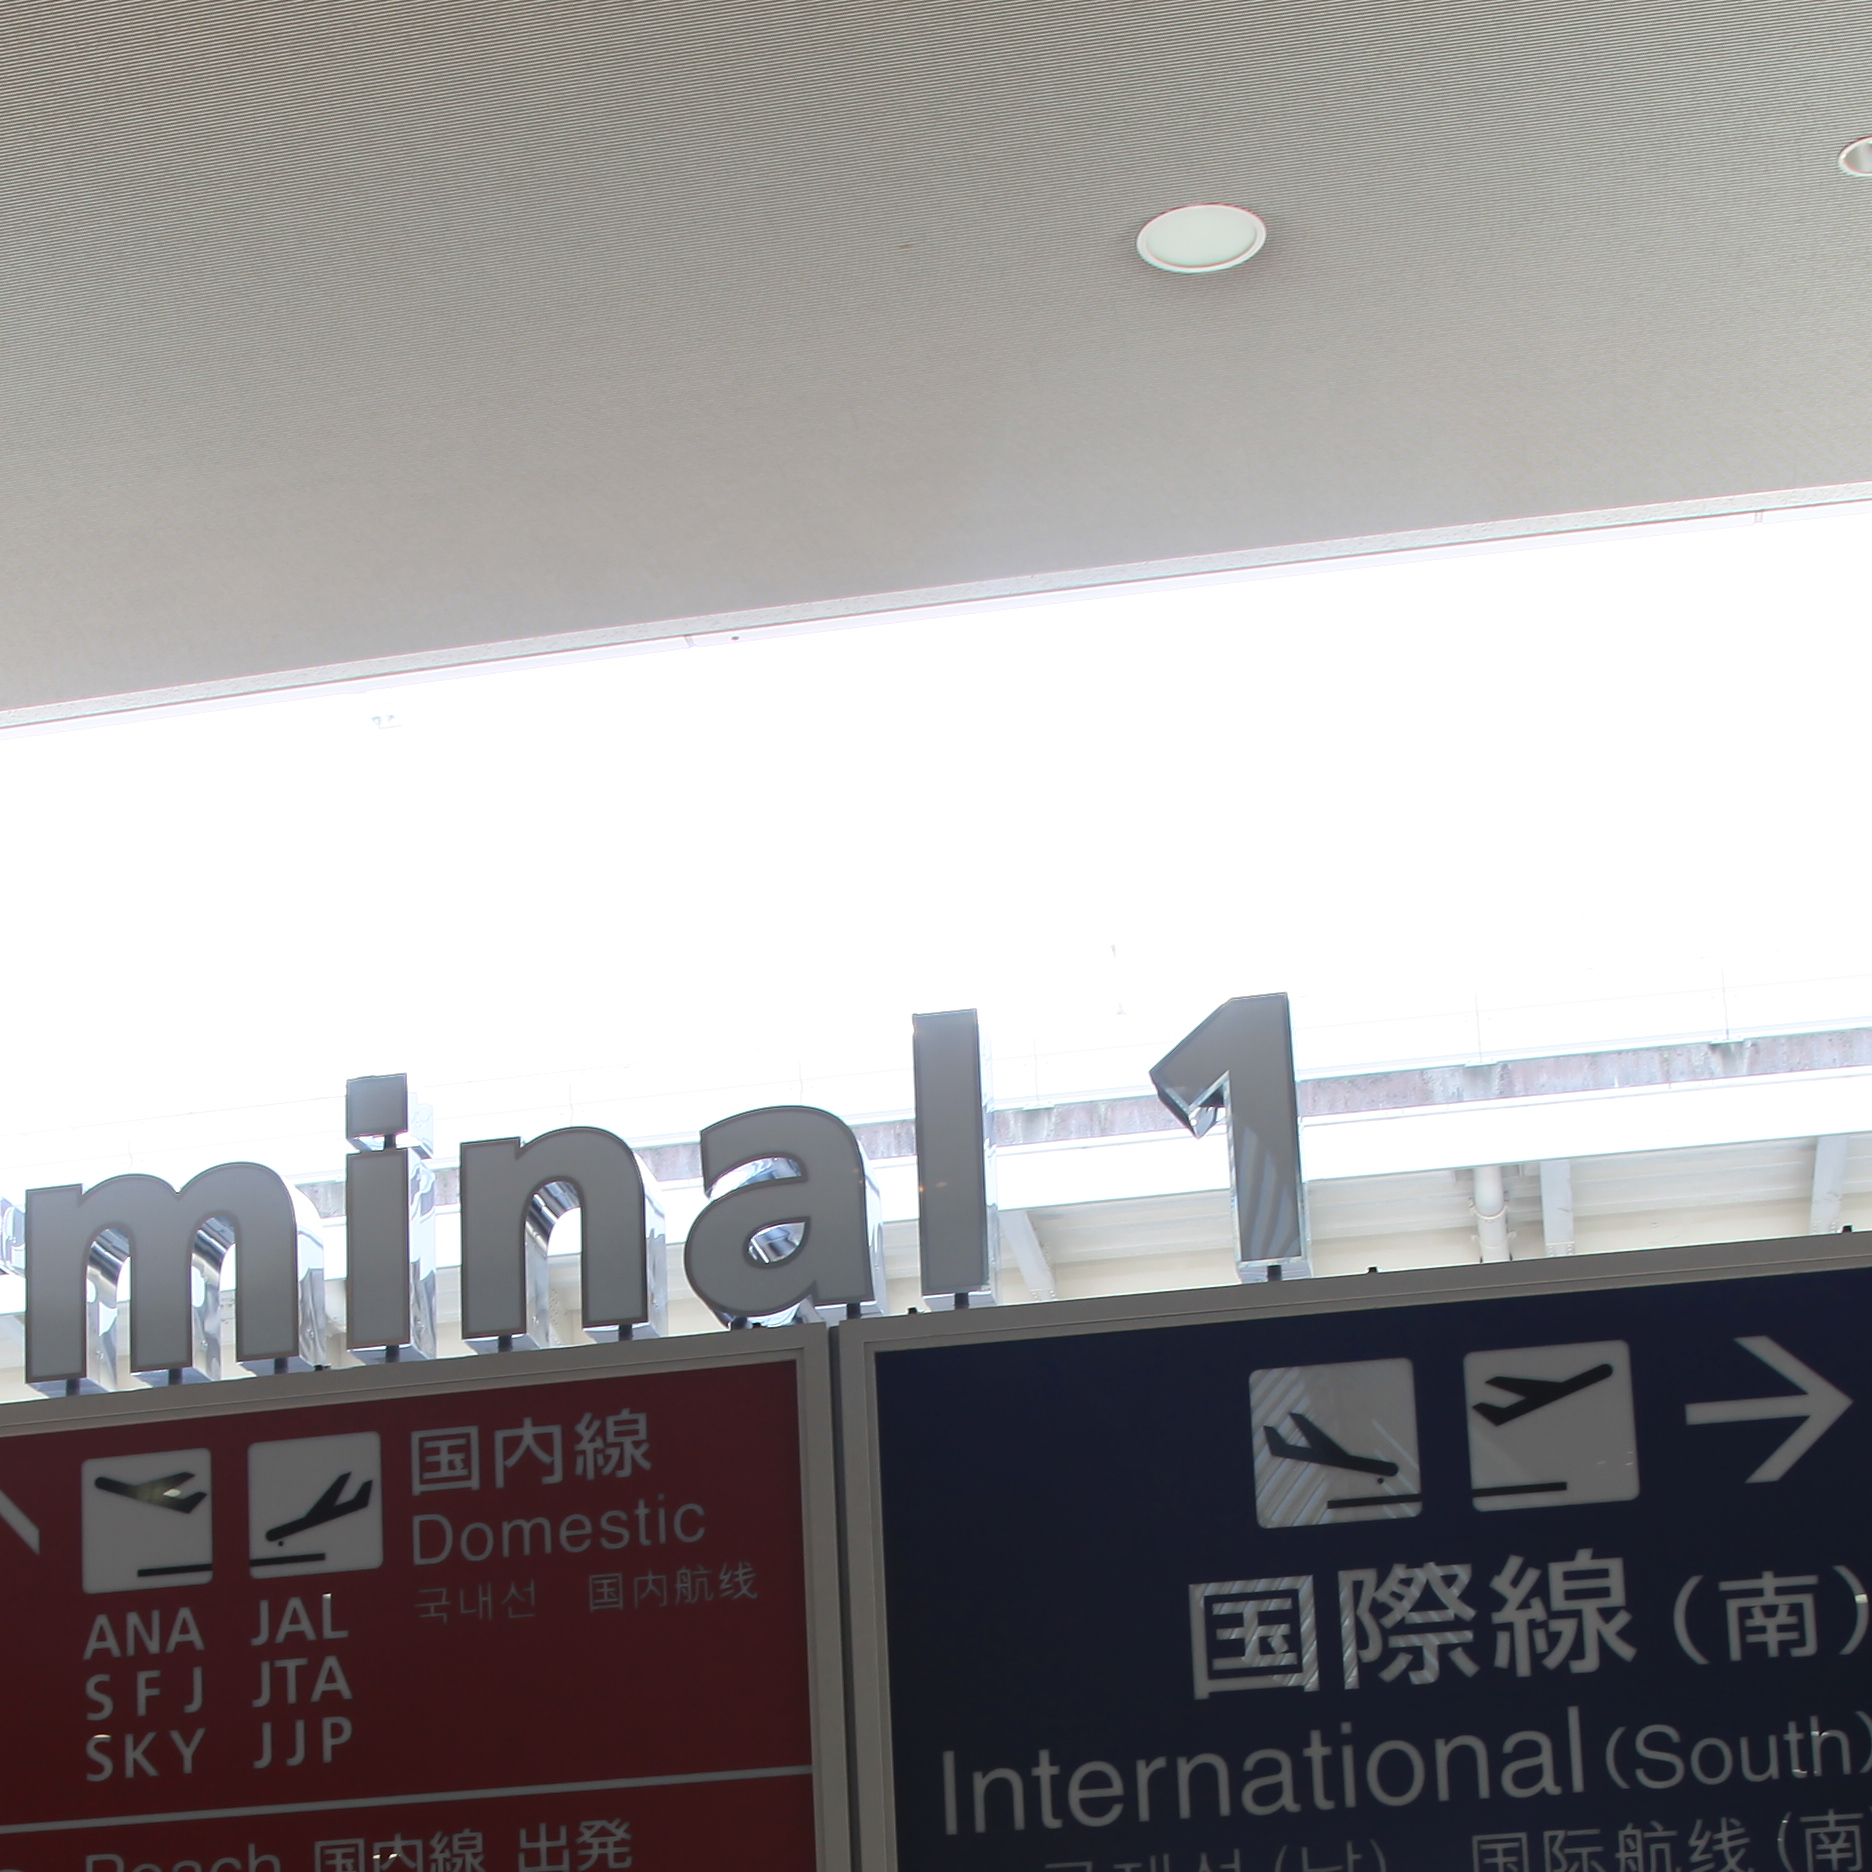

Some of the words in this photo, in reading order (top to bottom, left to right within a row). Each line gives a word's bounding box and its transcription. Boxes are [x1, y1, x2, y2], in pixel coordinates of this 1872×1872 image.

[1150, 992, 1303, 1281] 1
[410, 1407, 651, 1496] 国内線
[412, 1494, 706, 1567] Domestic
[82, 1607, 205, 1660] ANA
[250, 1593, 349, 1646] JAL
[417, 1580, 536, 1626] 국내선
[588, 1561, 759, 1613] 国内航线
[252, 1655, 353, 1706] JTA
[85, 1727, 206, 1782] SKY
[252, 1716, 354, 1769] JJP
[941, 1704, 1581, 1836] International
